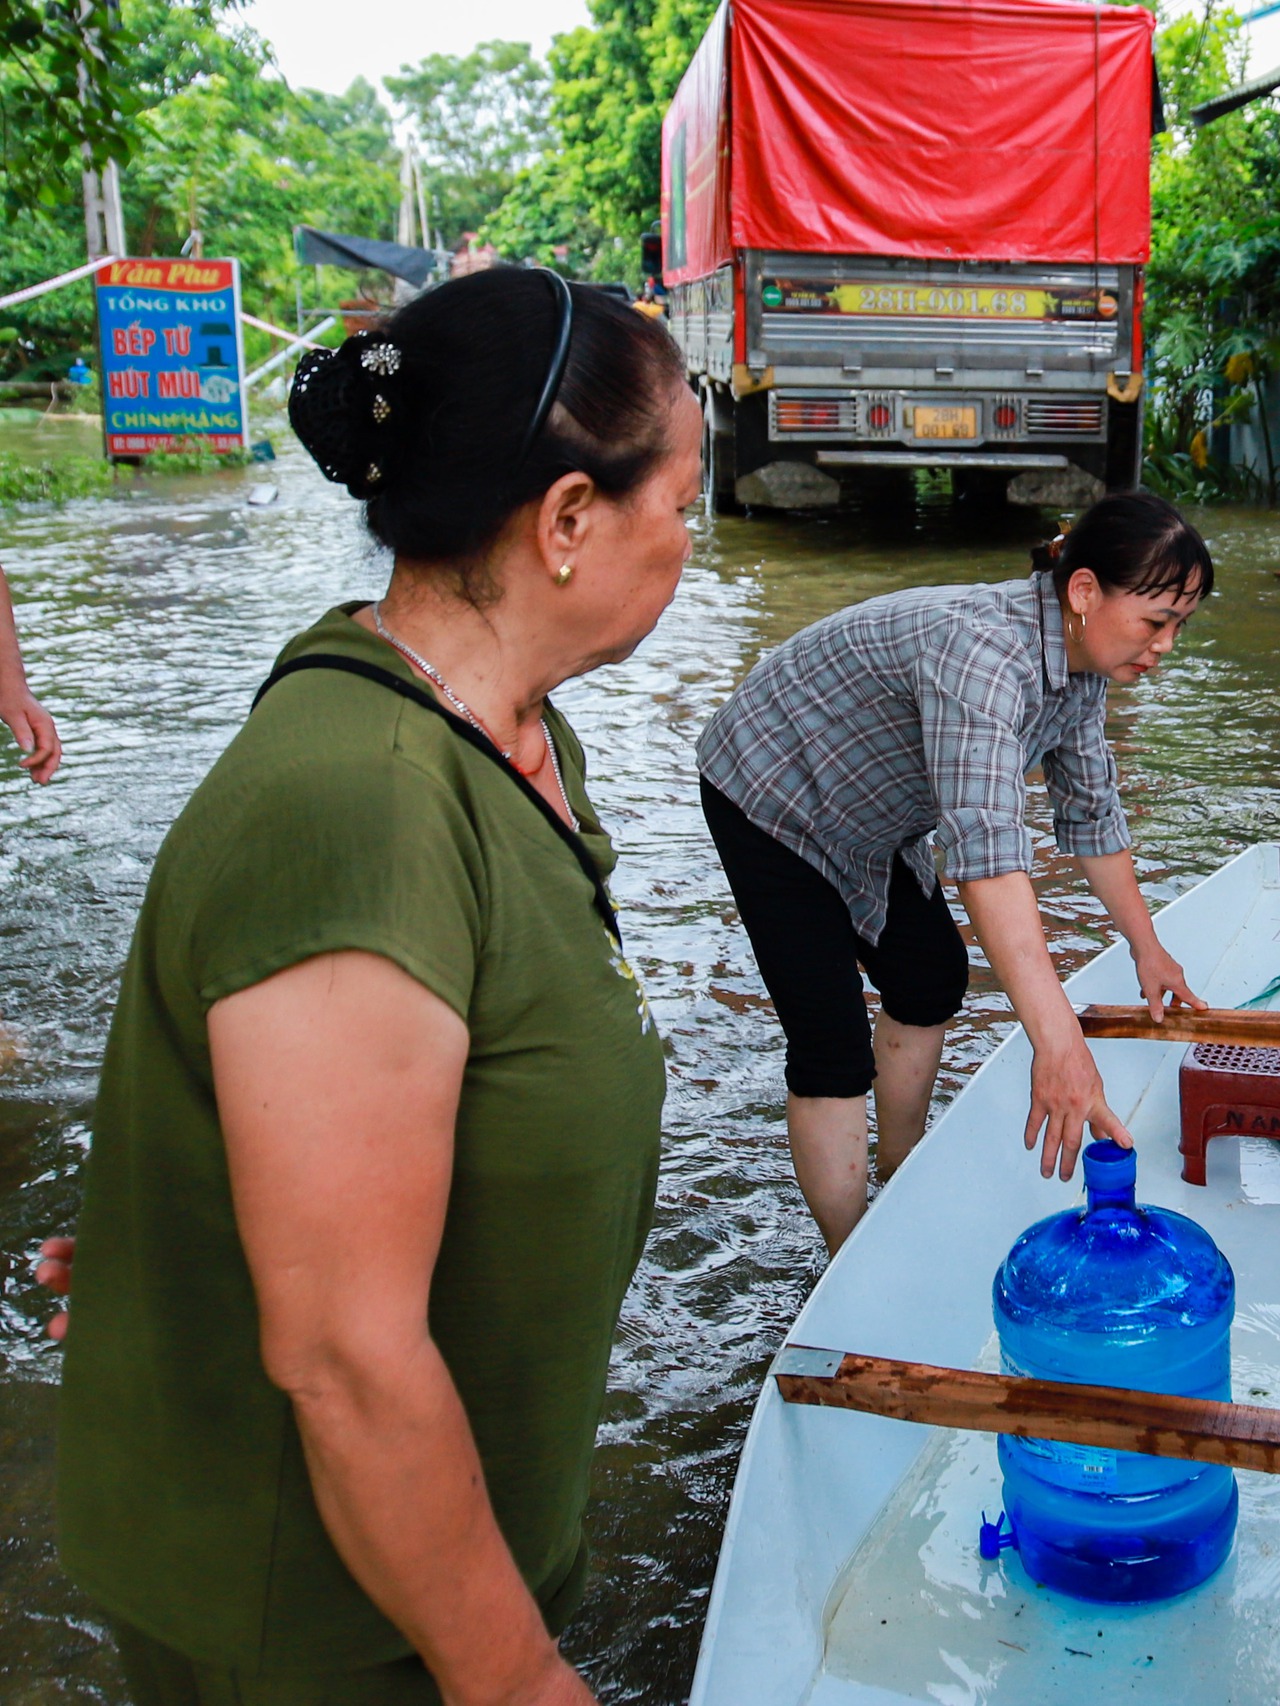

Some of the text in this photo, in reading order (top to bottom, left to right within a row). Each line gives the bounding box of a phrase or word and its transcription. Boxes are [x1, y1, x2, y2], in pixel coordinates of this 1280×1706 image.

[175, 298, 227, 312] KHO
[859, 287, 1027, 314] 28H-001.68
[112, 319, 191, 356] BẾP TỪ
[107, 365, 202, 399] HÚT MÙI
